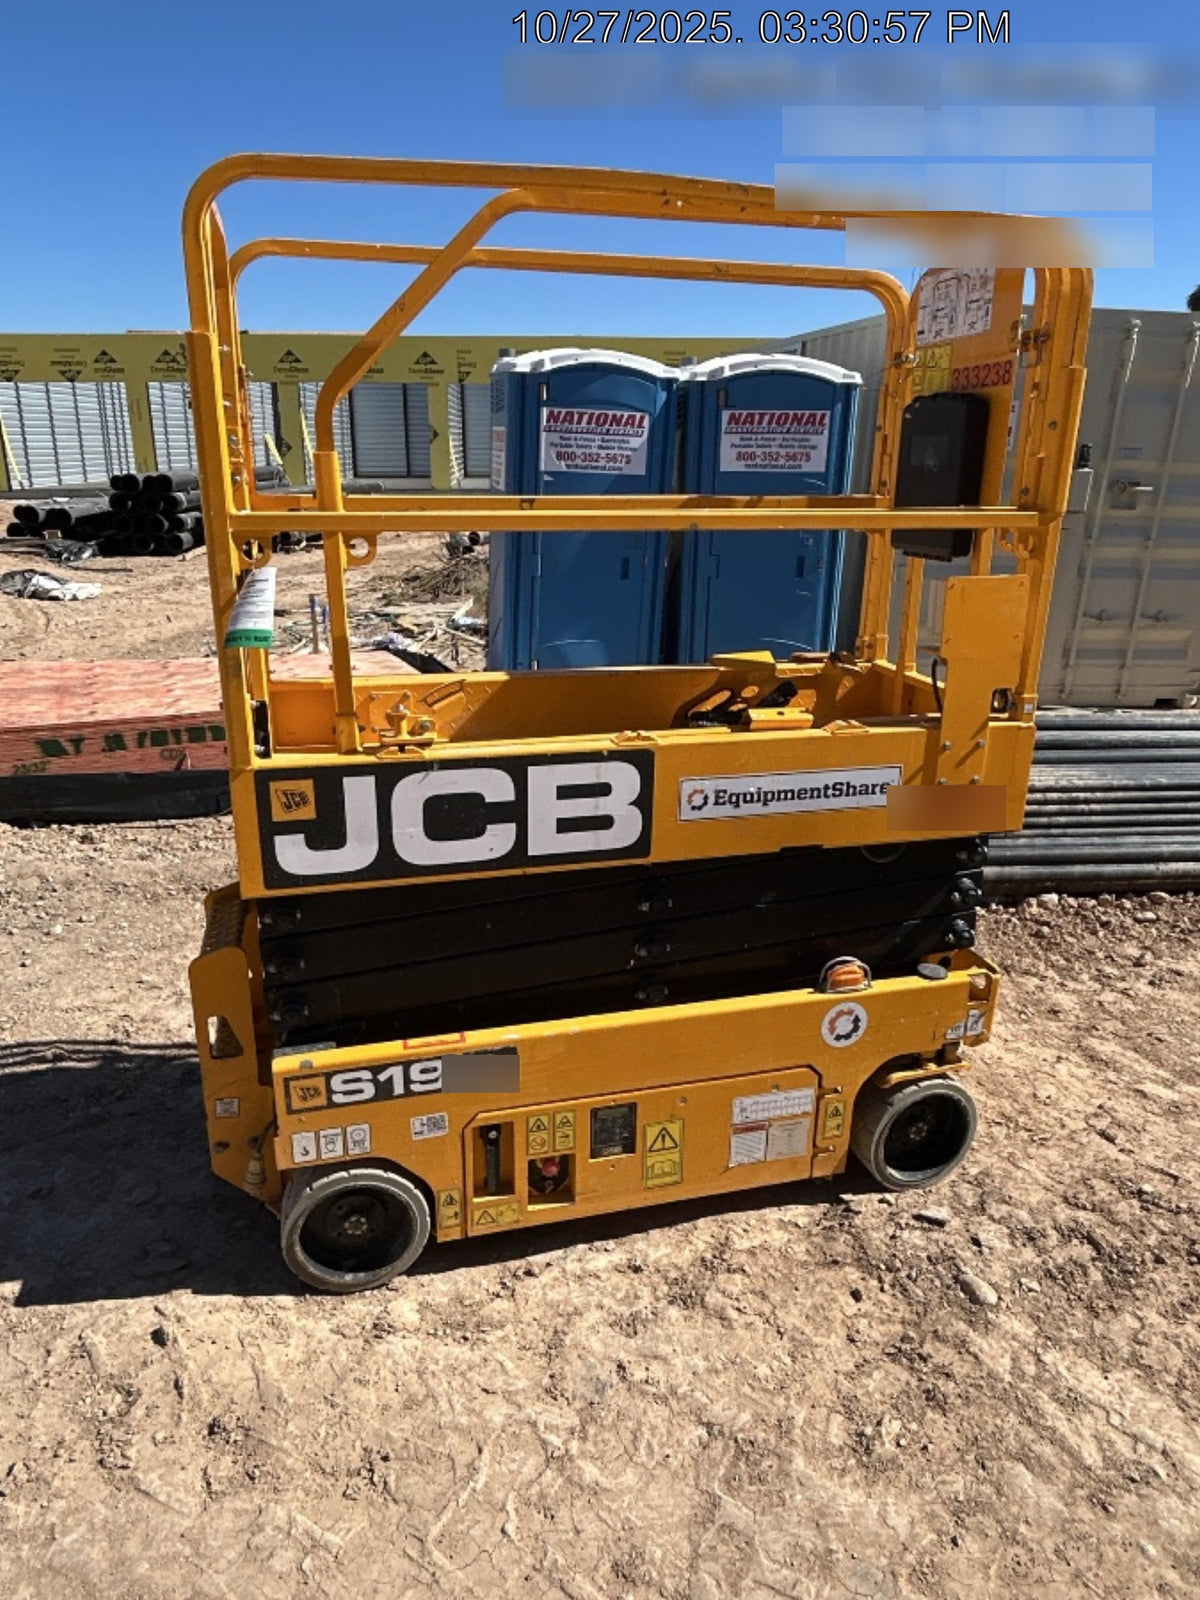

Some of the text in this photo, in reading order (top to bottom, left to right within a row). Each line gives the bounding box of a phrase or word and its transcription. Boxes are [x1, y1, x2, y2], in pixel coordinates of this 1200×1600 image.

[952, 360, 1012, 391] 333238
[546, 409, 645, 429] NATIONAL
[727, 412, 827, 427] NATIONAL
[556, 451, 632, 464] 800-352-5675
[736, 450, 811, 463] 800-352-5675
[282, 790, 311, 809] JCB
[712, 781, 889, 809] EquipmentShare
[274, 761, 643, 876] JCB
